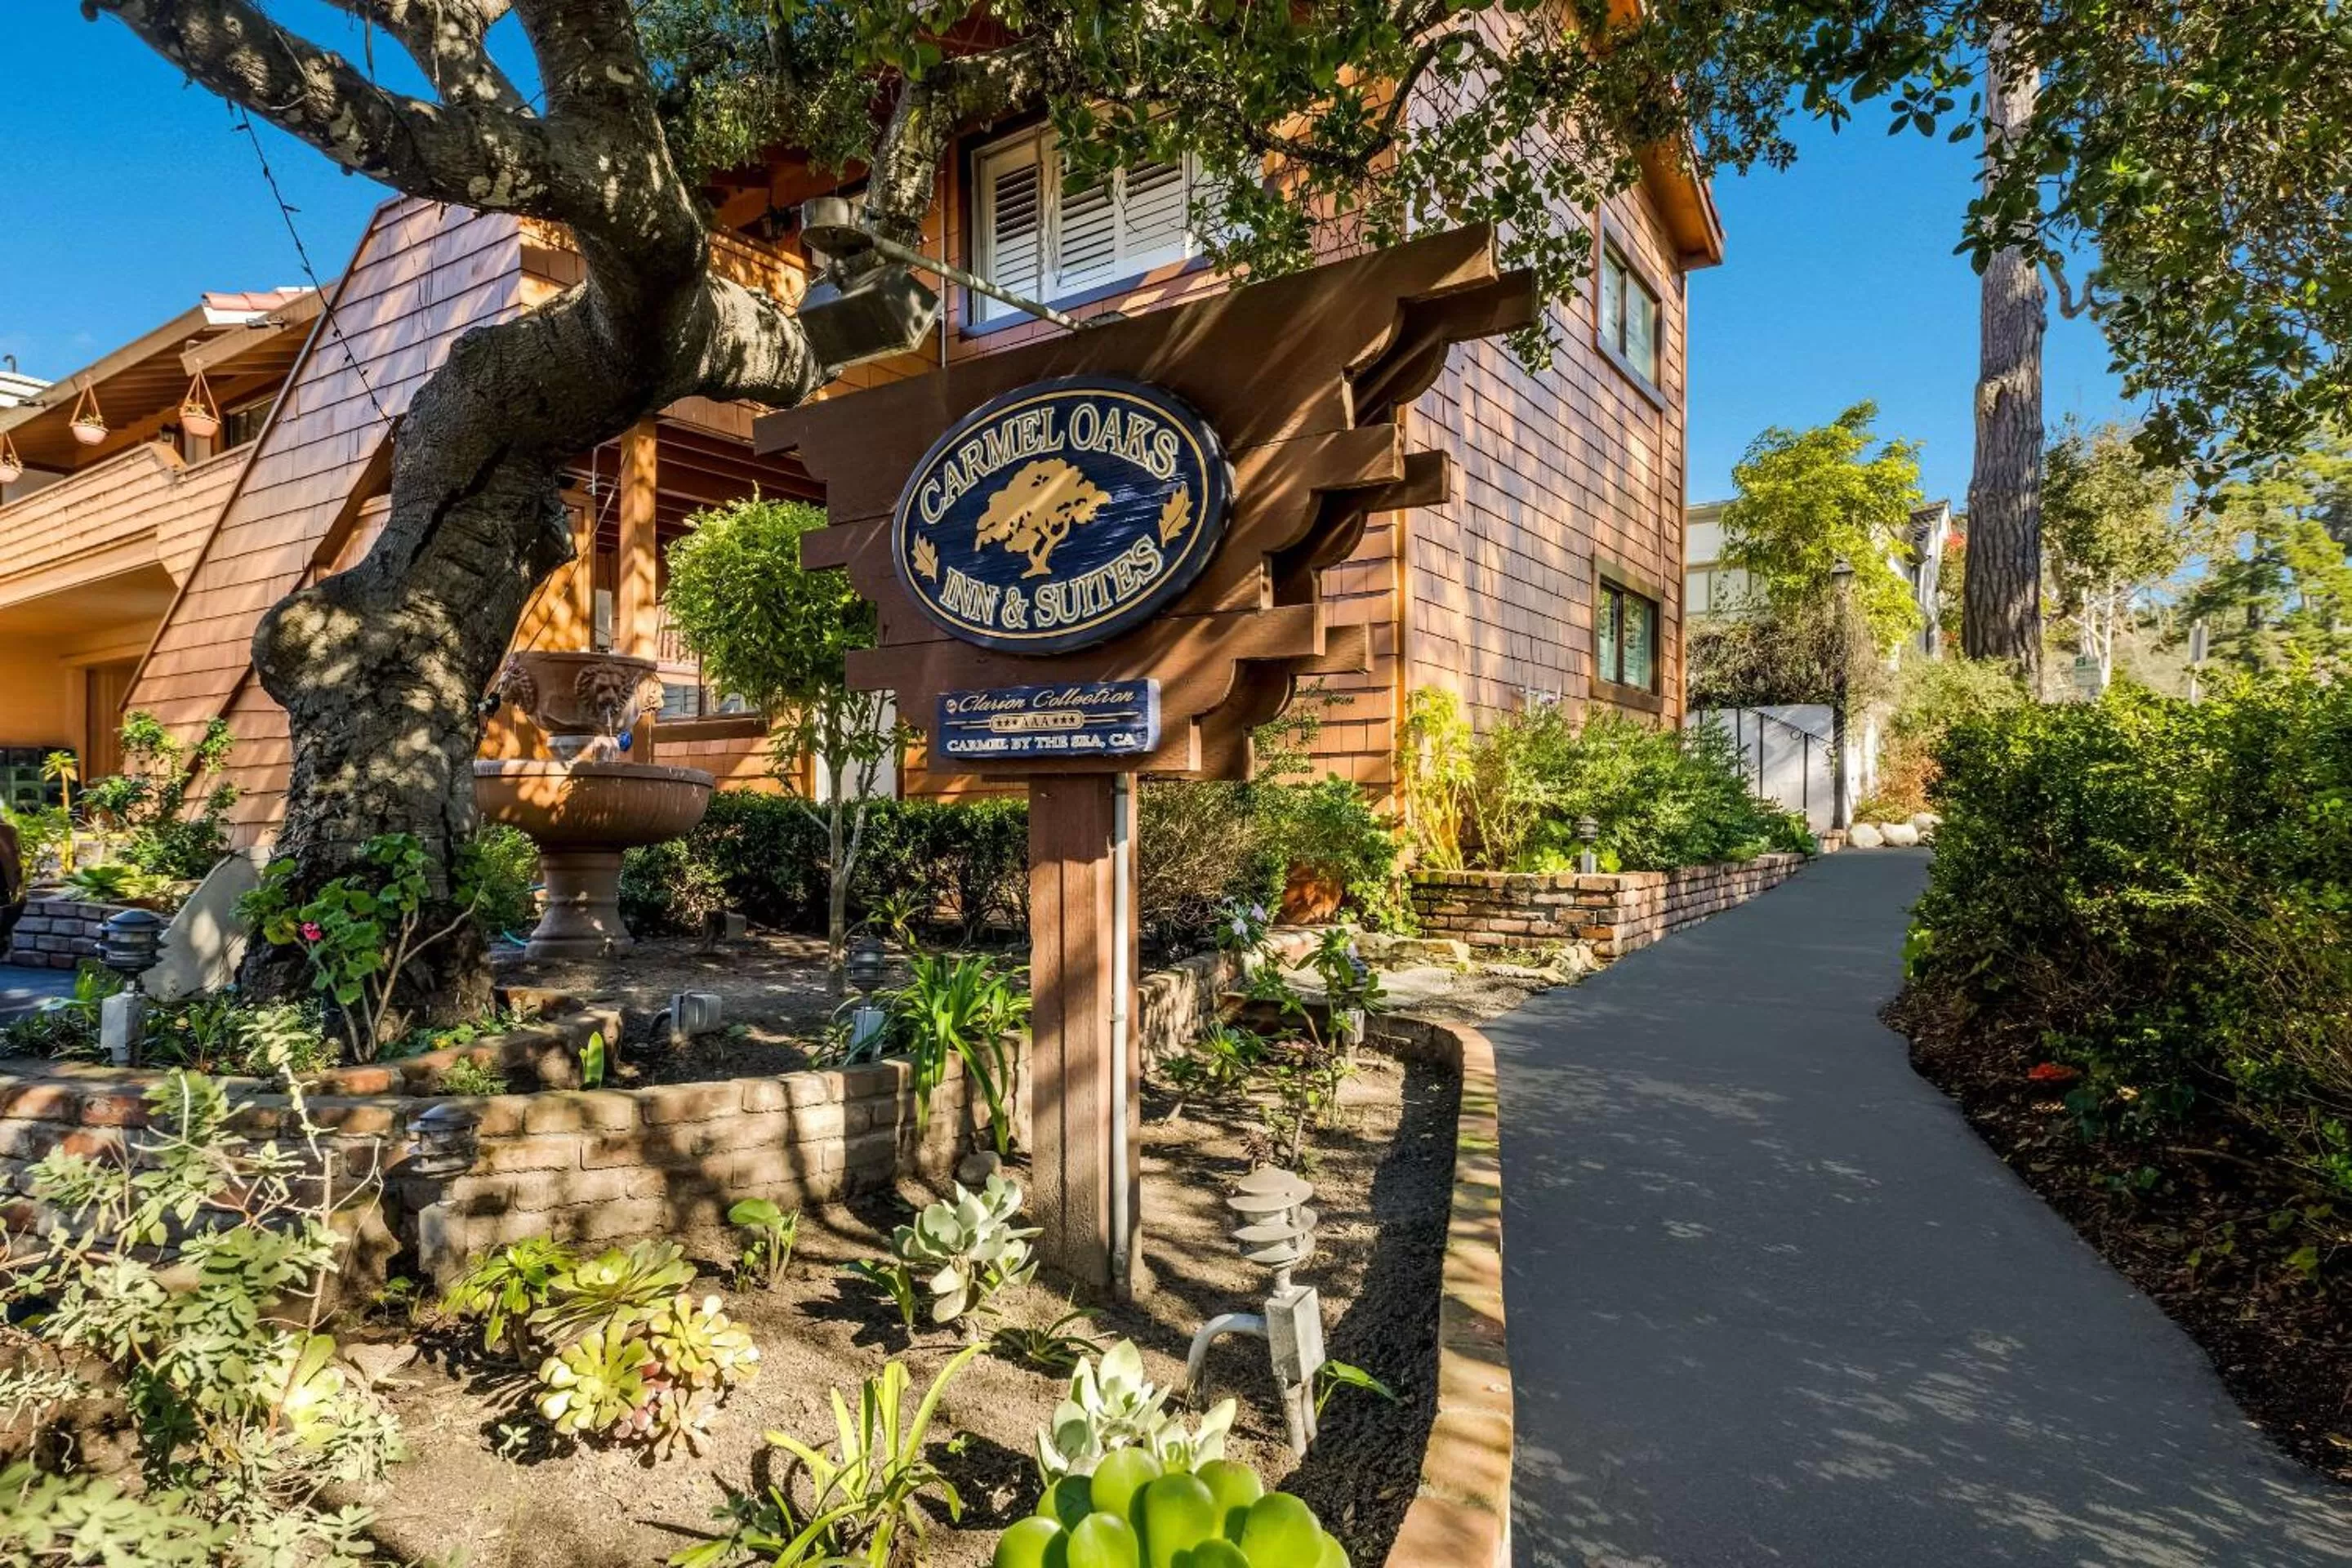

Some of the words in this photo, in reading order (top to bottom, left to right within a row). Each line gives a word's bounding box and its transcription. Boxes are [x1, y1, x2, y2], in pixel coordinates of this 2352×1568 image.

[920, 407, 1064, 524] CARMEL
[1068, 403, 1178, 479] OAKS
[939, 567, 1000, 626] INN
[1001, 587, 1029, 630] &
[1034, 535, 1164, 628] SUITES
[959, 693, 1026, 713] Clarion
[1032, 687, 1135, 708] Collection
[947, 737, 1009, 752] CARMEL
[1010, 737, 1032, 751] BY
[1034, 735, 1068, 749] THE
[1071, 734, 1106, 749] SEA,
[1108, 733, 1135, 746] CA
